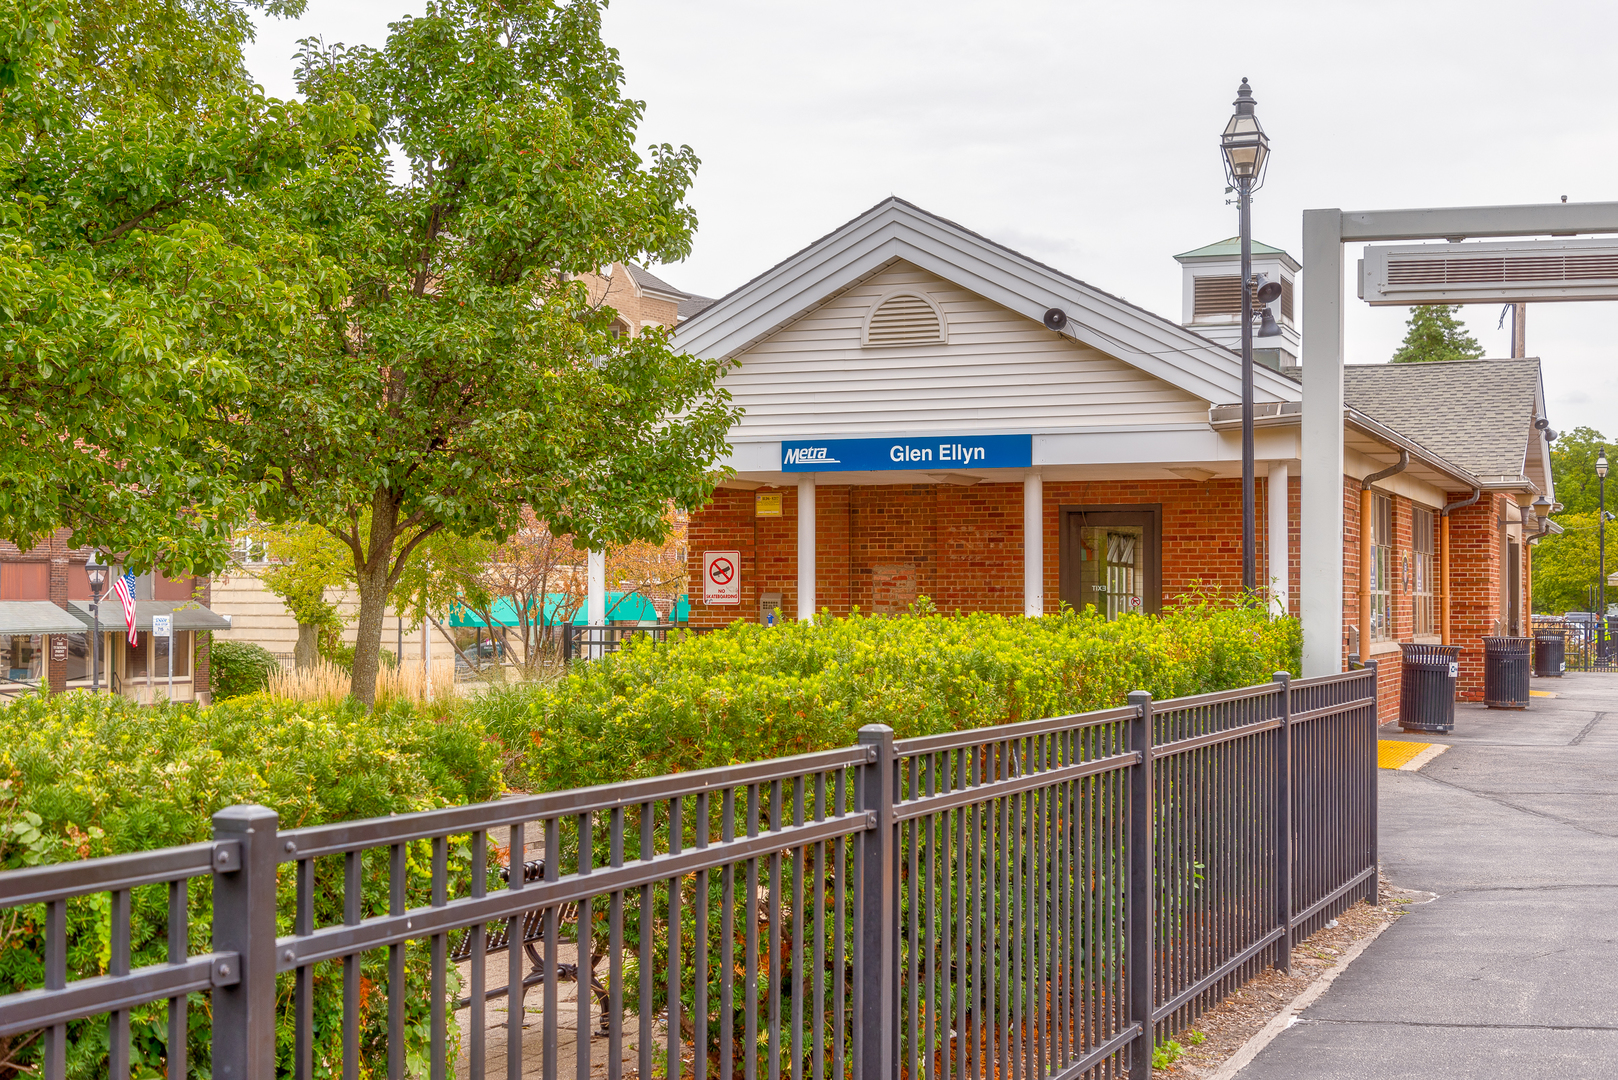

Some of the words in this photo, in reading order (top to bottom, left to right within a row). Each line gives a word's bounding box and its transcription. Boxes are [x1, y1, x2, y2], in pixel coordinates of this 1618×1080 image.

[784, 446, 830, 464] Metra
[890, 445, 932, 462] Glen
[939, 444, 985, 465] Ellyn
